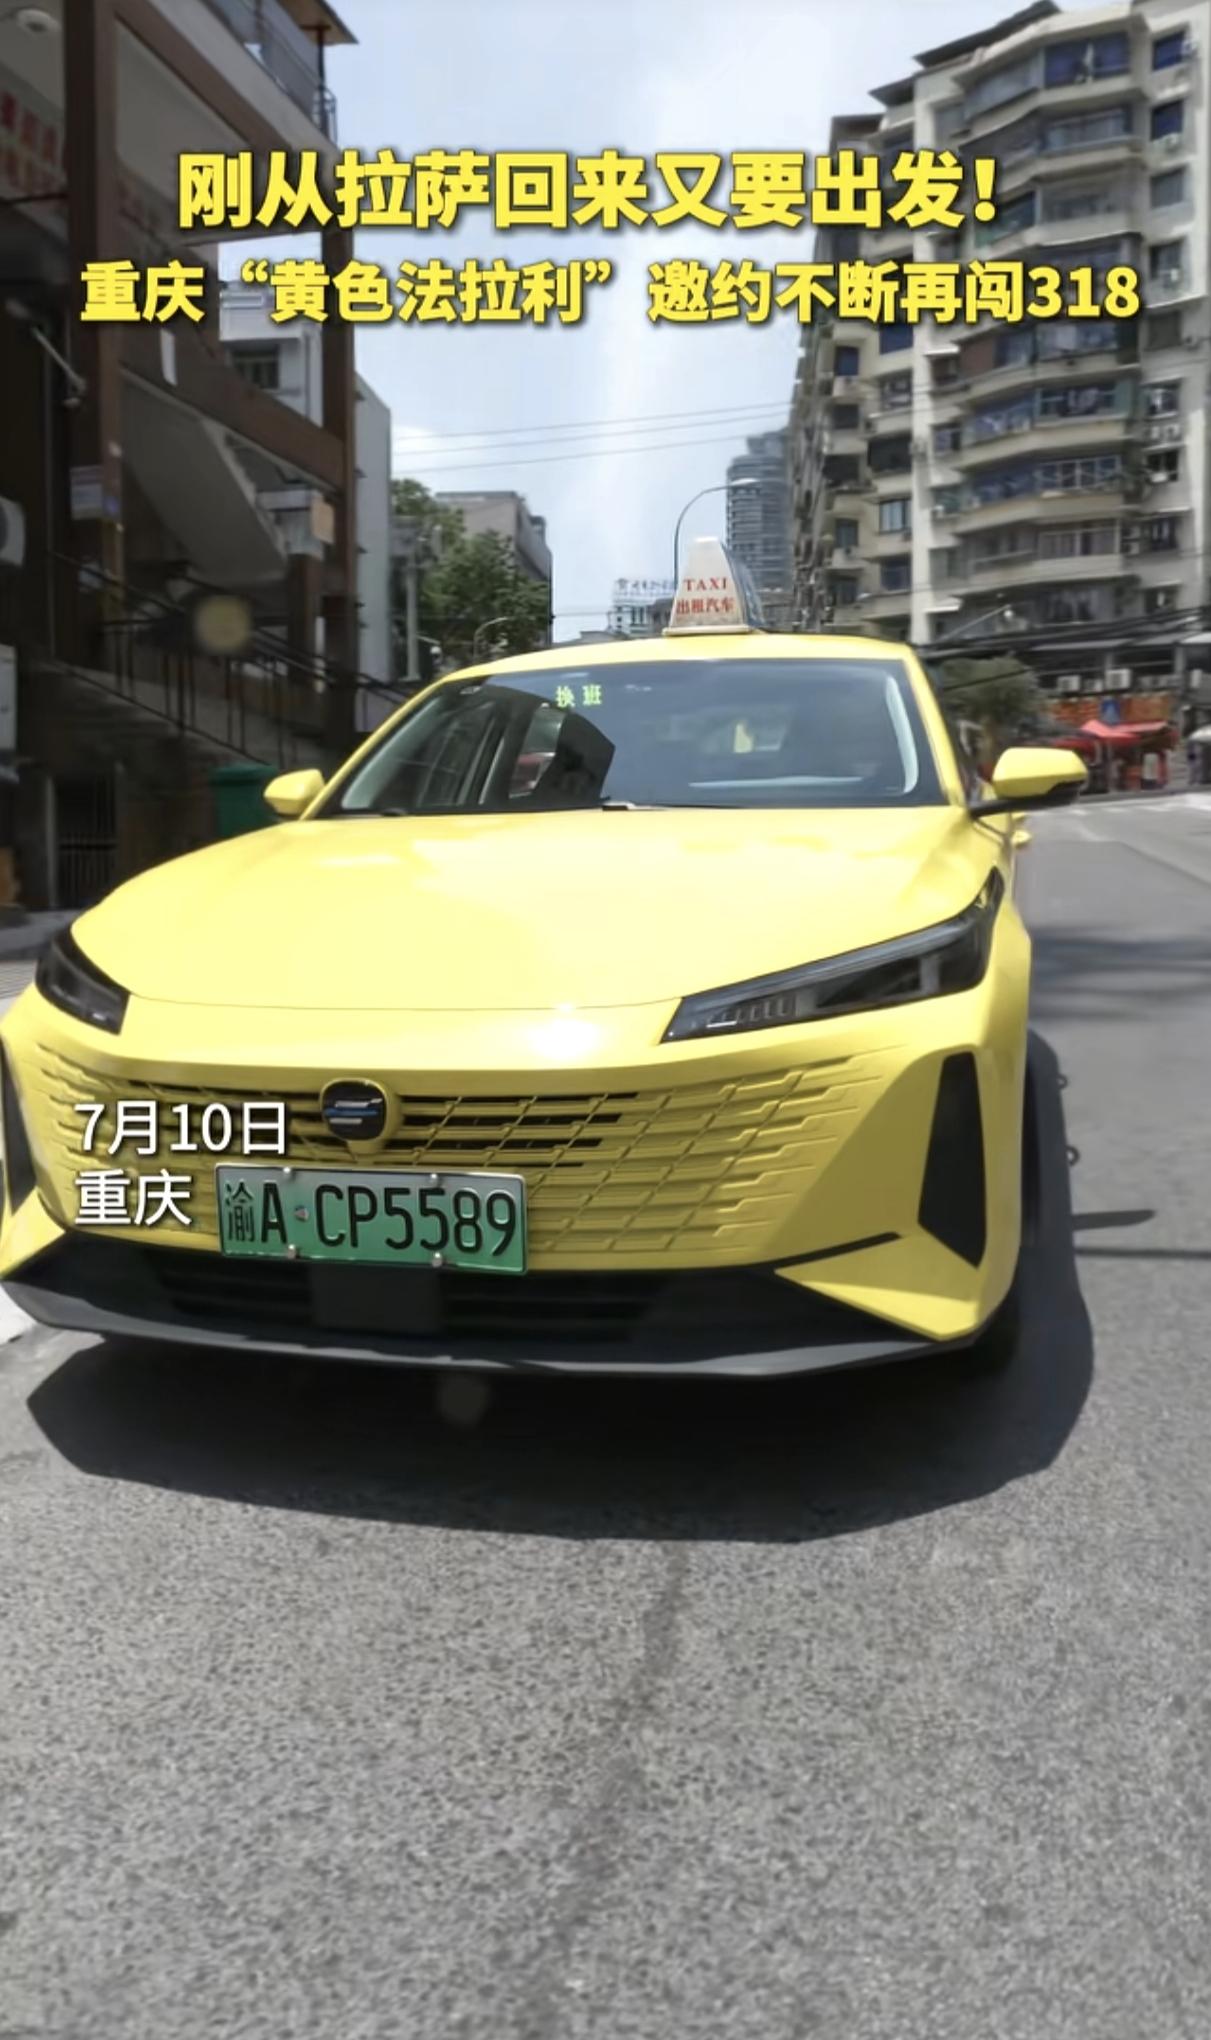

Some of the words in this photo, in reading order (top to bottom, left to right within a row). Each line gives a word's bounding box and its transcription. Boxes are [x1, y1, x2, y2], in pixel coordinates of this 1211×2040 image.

[683, 577, 728, 591] TAXI
[676, 597, 733, 614] 出租汽车
